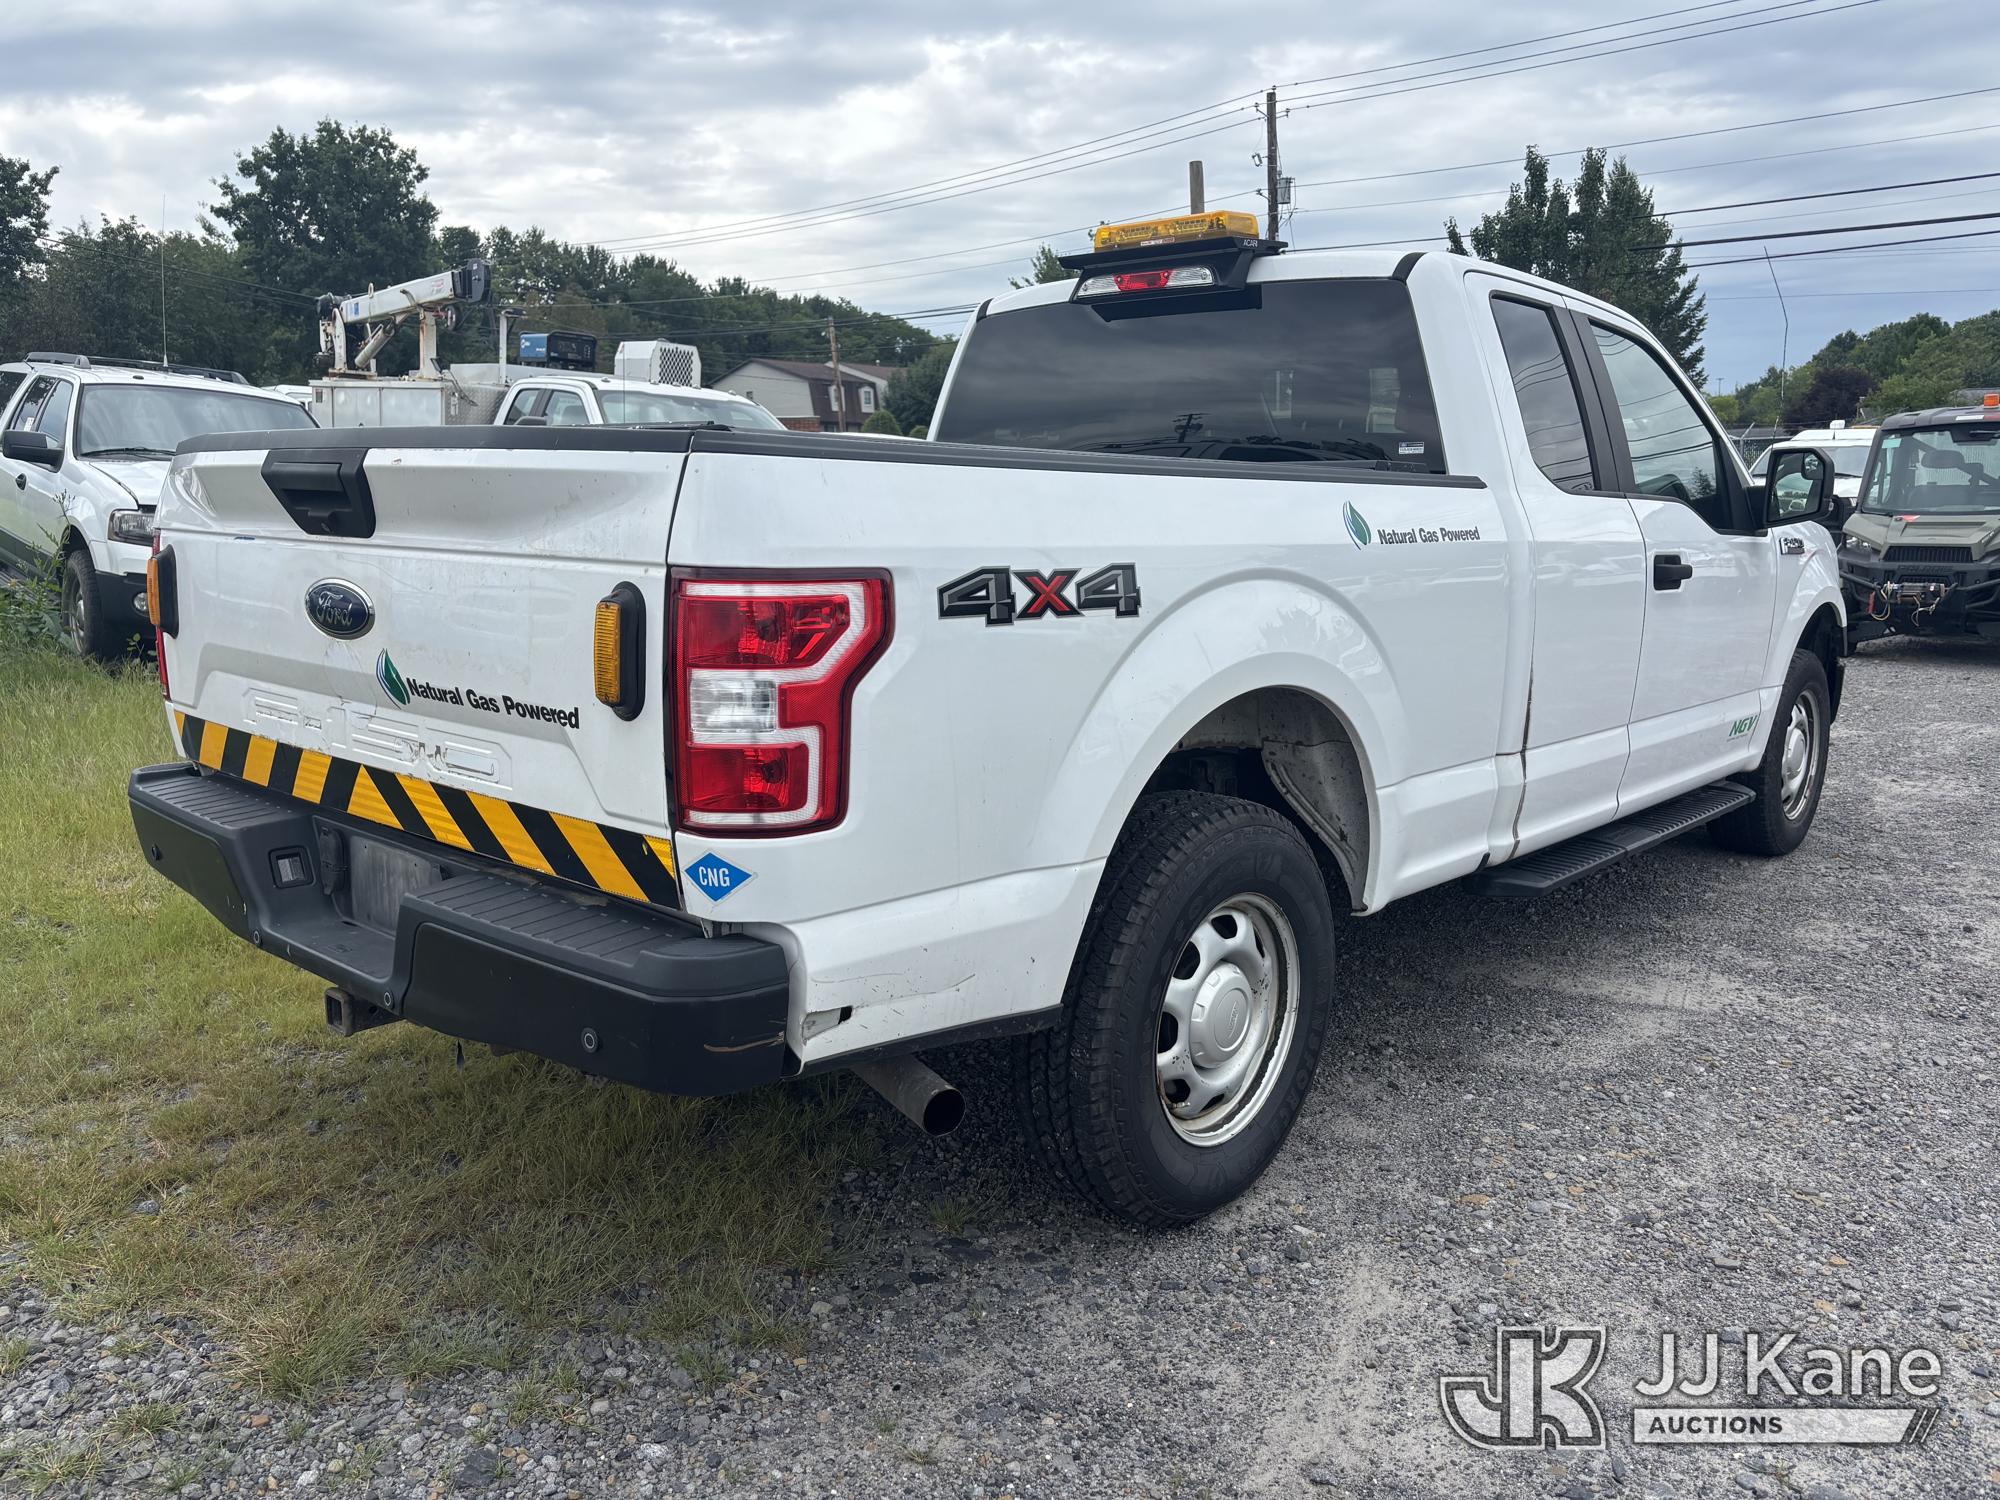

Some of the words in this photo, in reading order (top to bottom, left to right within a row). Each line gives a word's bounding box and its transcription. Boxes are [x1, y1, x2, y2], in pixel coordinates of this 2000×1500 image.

[1377, 528, 1418, 545] Natural
[1419, 527, 1439, 543] Gas
[1440, 526, 1481, 542] Powered
[317, 590, 354, 626] Ford
[406, 677, 465, 706] Natural
[466, 688, 501, 713] Gas
[501, 694, 580, 729] Powered
[1729, 714, 1758, 737] NGV
[698, 866, 731, 888] CNG
